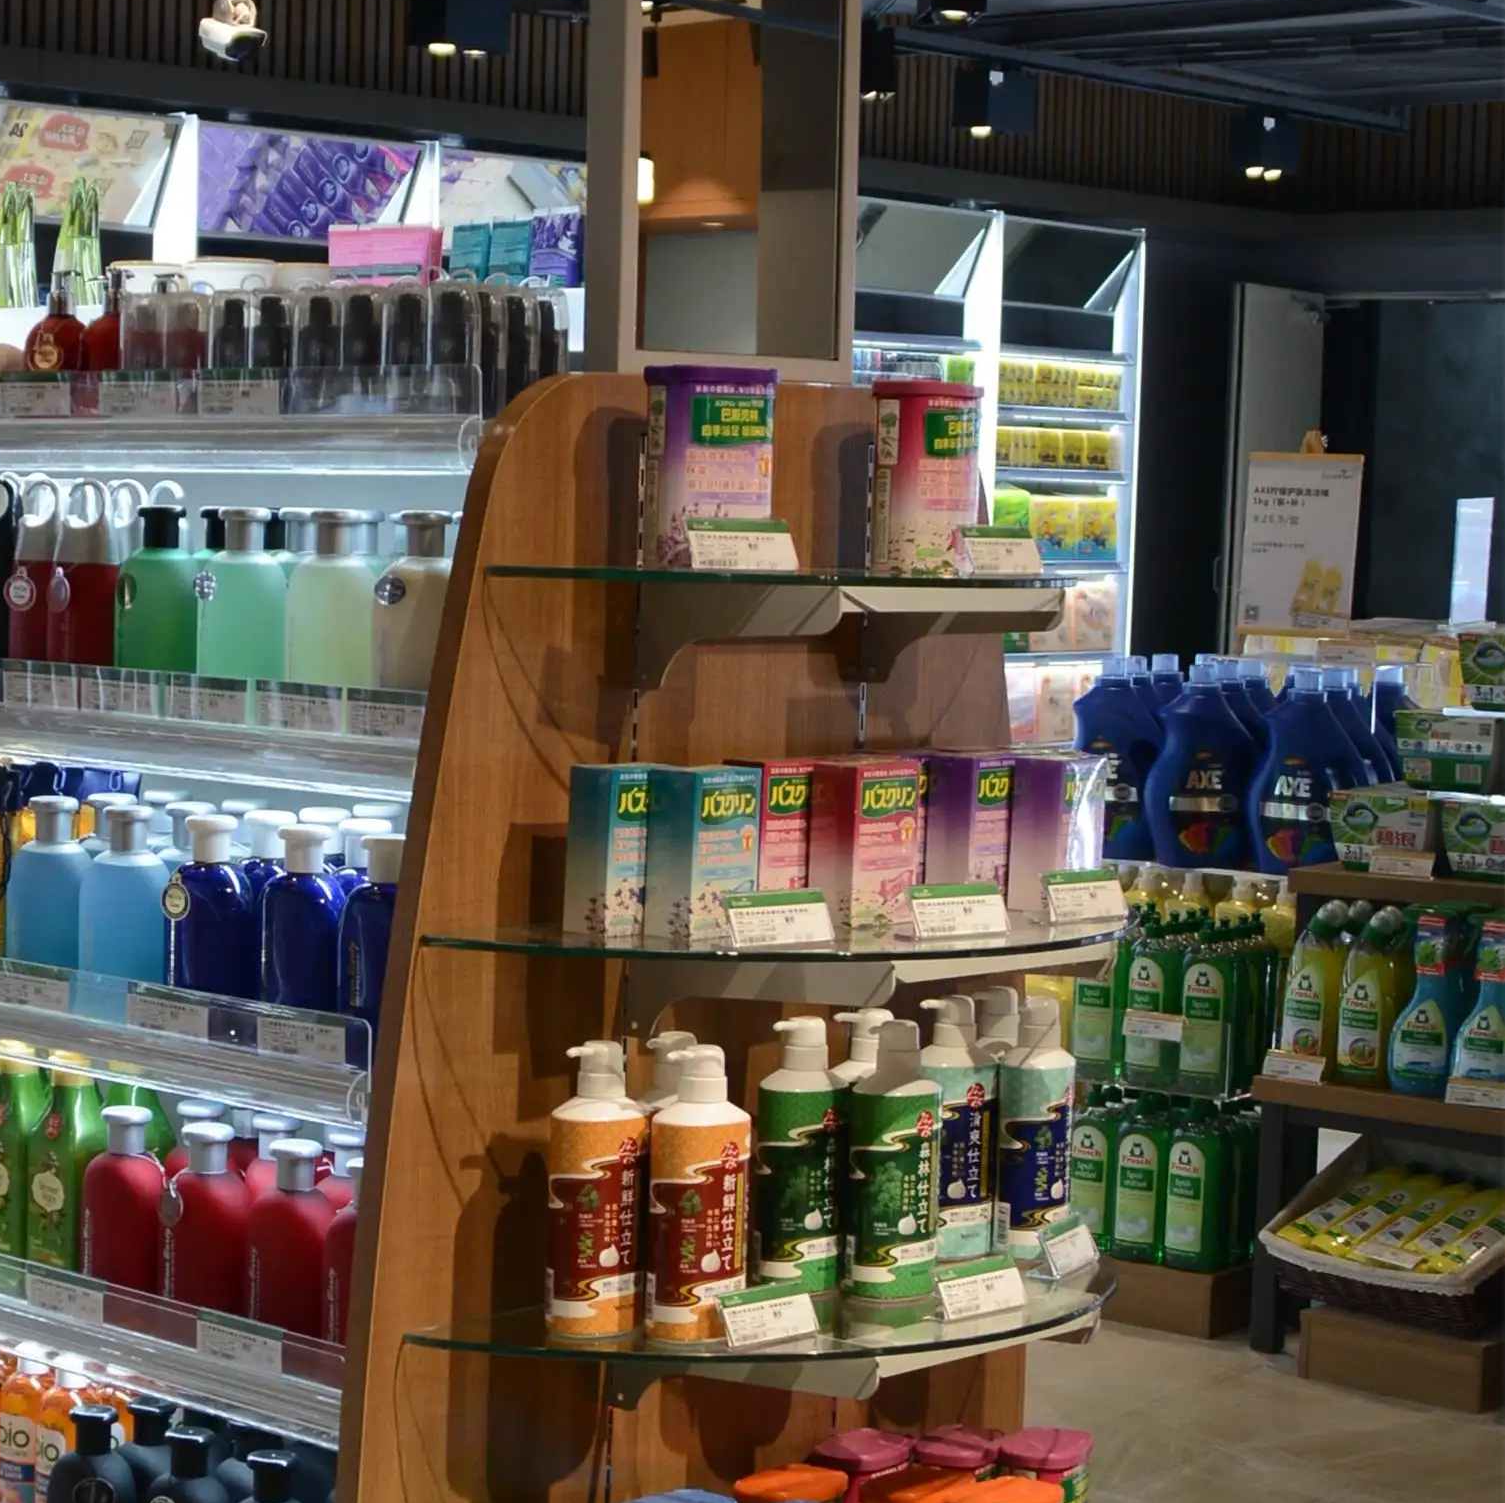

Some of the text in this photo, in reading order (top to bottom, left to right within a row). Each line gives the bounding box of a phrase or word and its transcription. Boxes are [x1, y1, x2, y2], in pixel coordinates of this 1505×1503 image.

[978, 773, 1010, 798] バスク
[1186, 770, 1224, 791] AXE
[1274, 773, 1313, 798] AXE
[702, 790, 757, 818] バスクリン
[770, 780, 808, 808] バスク
[862, 784, 917, 810] バスクリン
[1376, 829, 1417, 847] 碧浪
[1131, 977, 1159, 989] Frosch
[1187, 984, 1218, 995] Frosch
[1291, 988, 1320, 1000] Frosch
[1346, 997, 1377, 1009] Frosch
[1407, 1020, 1437, 1031] Frosch
[966, 1110, 983, 1199] 清爽仕立て
[1073, 1145, 1102, 1157] Frosch
[1122, 1154, 1153, 1166] Frosch
[1171, 1162, 1200, 1174] Frosch
[916, 1141, 931, 1234] 森林仕立て
[619, 1169, 636, 1266] 新鮮仕立て
[721, 1173, 737, 1271] 新鮮仕立て
